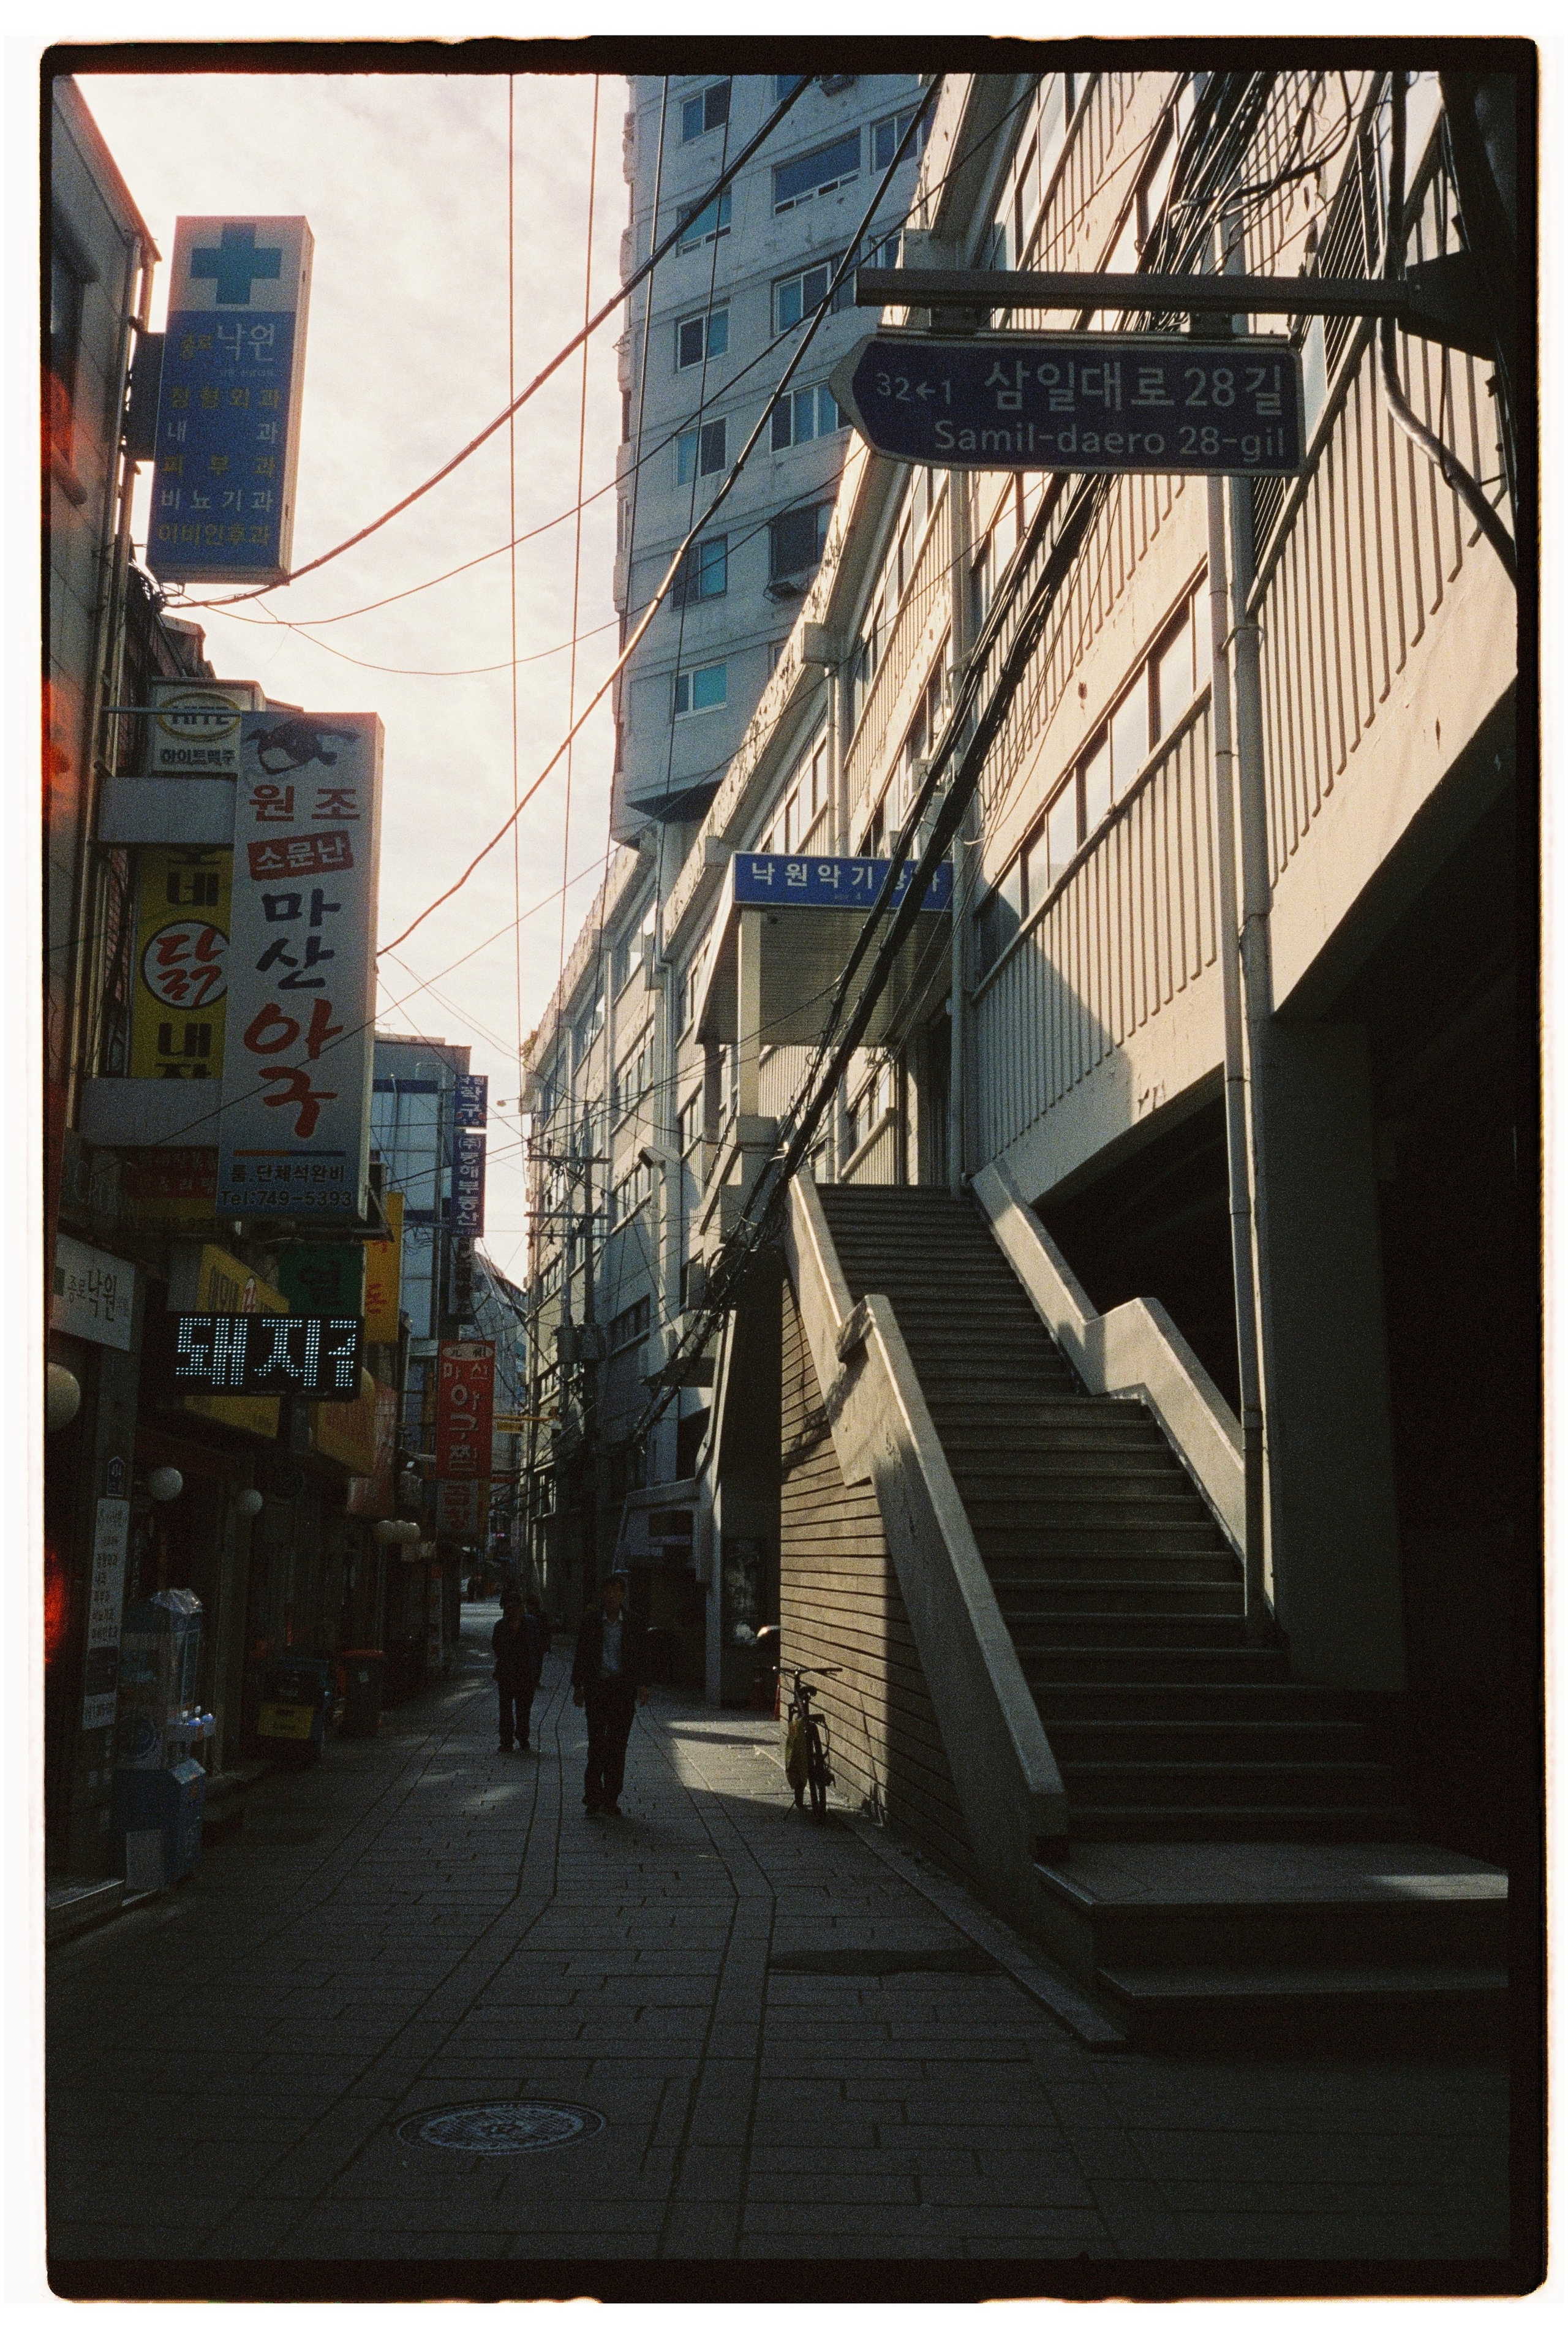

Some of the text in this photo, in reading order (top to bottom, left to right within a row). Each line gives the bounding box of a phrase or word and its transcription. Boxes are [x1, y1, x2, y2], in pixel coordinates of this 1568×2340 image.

[217, 323, 276, 361] 낙원
[170, 387, 280, 410] 정형외과
[875, 372, 911, 402] 32
[933, 420, 1285, 464] Samil-daero 28-gil
[160, 488, 274, 512] 비뇨기과
[158, 523, 270, 546] 이비인후과
[162, 749, 236, 765] 하이트맥주
[249, 784, 361, 823] 원조
[257, 837, 347, 870] 소문난
[221, 1190, 352, 1207] Tel:749-5393
[67, 1275, 86, 1304] 종로
[88, 1269, 118, 1323] 낙원
